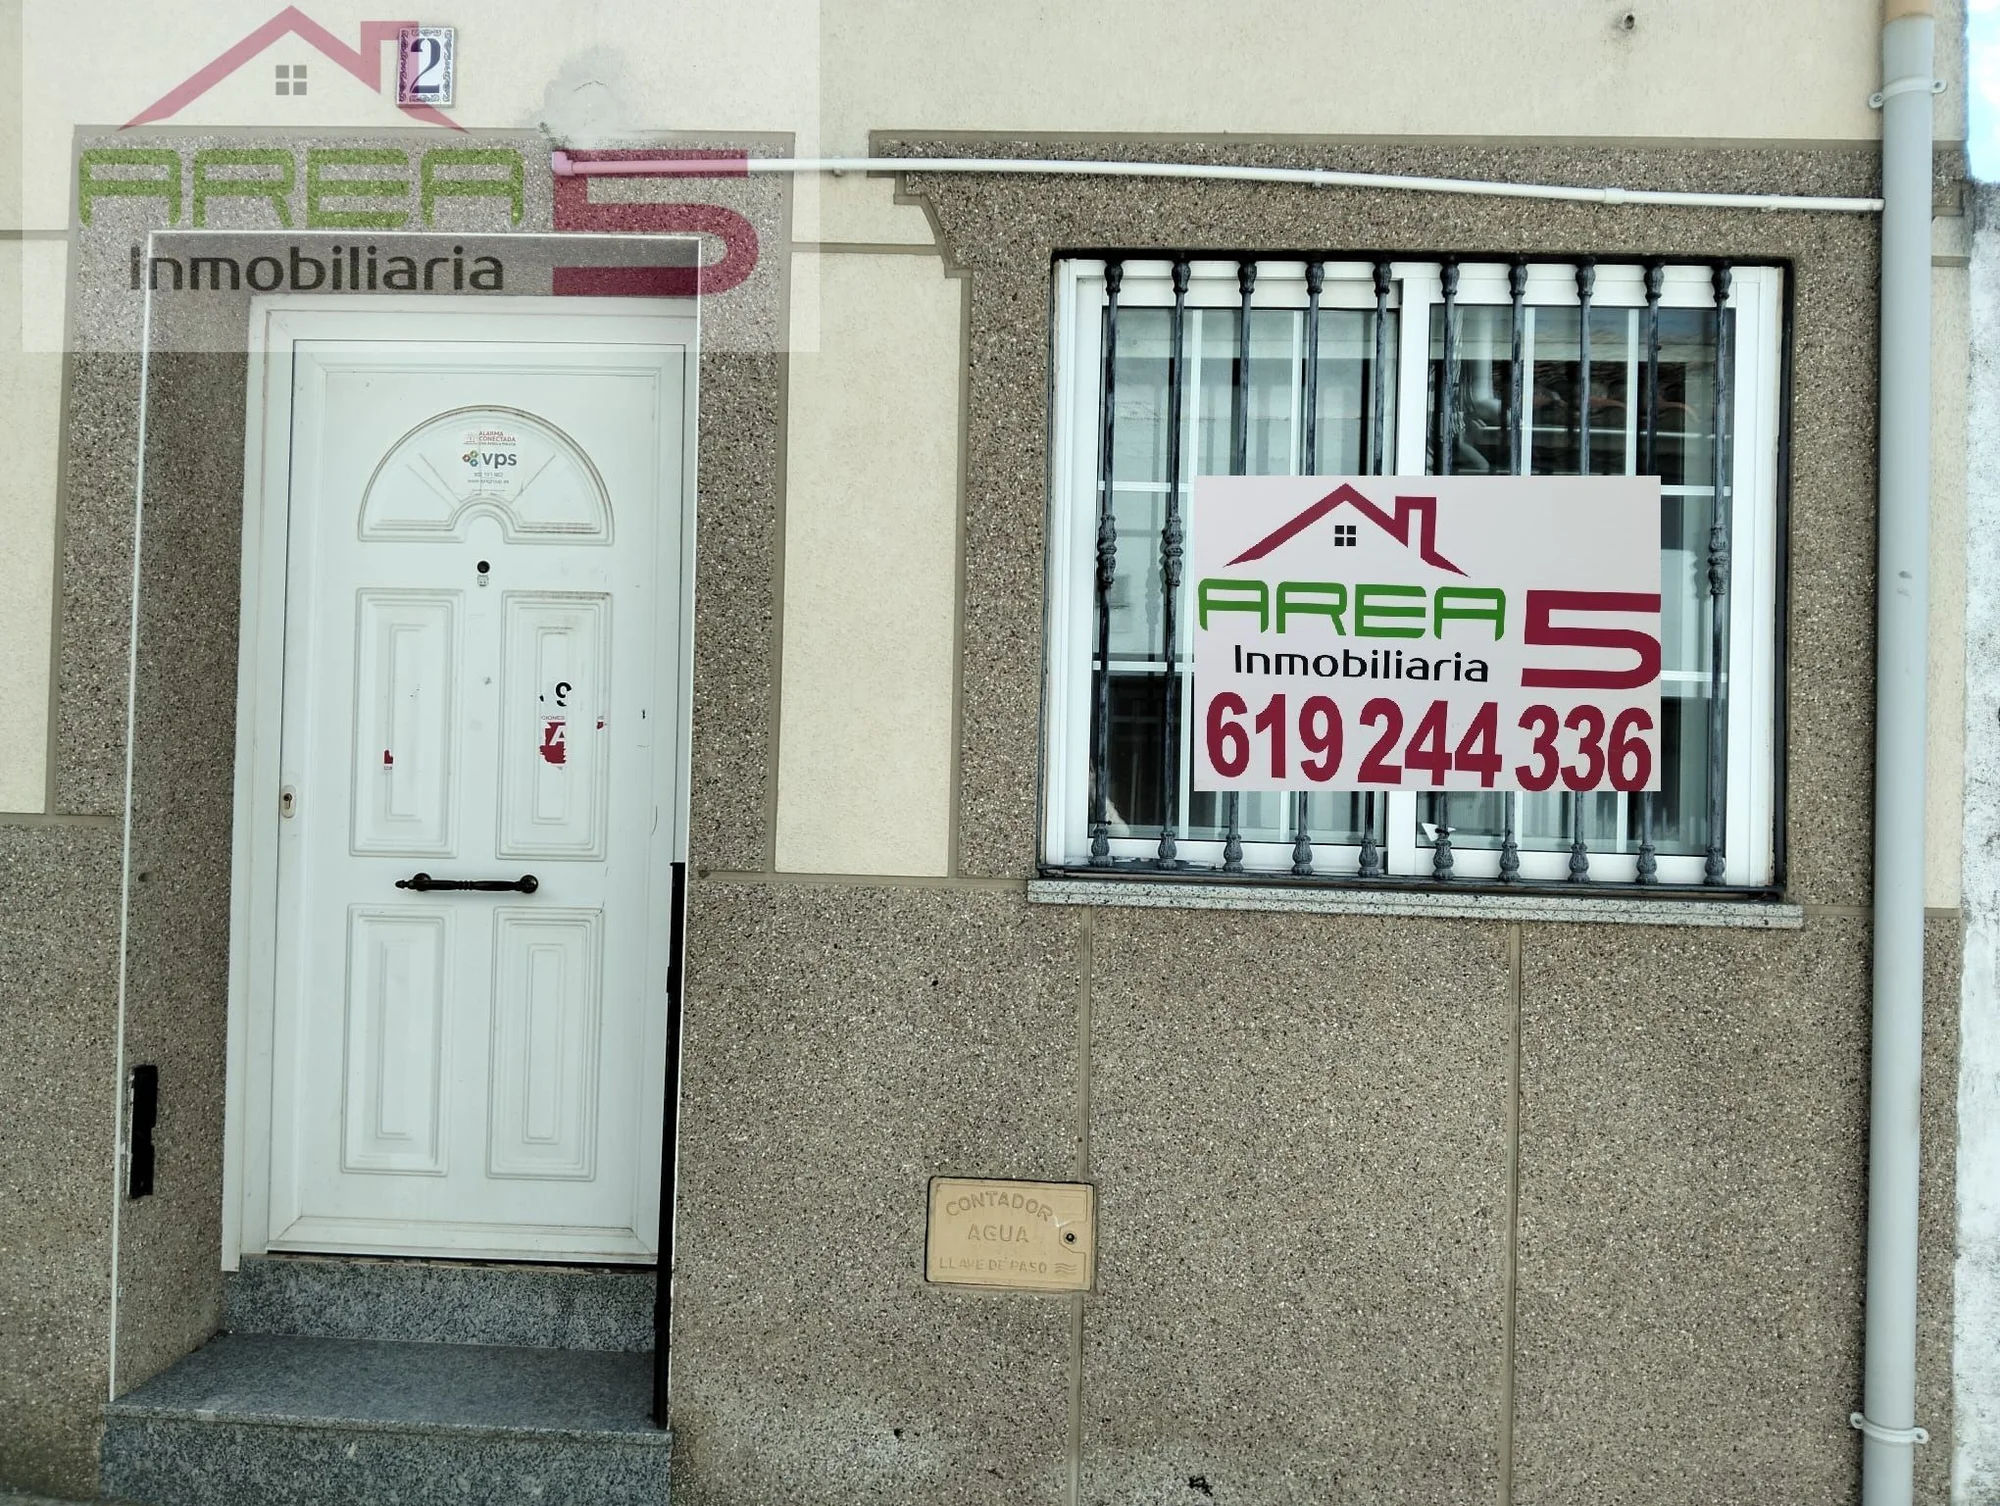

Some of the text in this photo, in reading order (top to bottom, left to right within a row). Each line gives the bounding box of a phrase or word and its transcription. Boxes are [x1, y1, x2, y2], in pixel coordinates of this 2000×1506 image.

[409, 37, 441, 94] 2
[482, 453, 517, 469] vps
[1198, 578, 1661, 690] AREA 5
[1235, 645, 1489, 683] Inmobiliaria
[1207, 692, 1653, 792] 619 244 336
[946, 1191, 1054, 1222] CONTADOR
[968, 1223, 1029, 1243] AGUA
[939, 1257, 1048, 1274] LLAVE DE PASO
